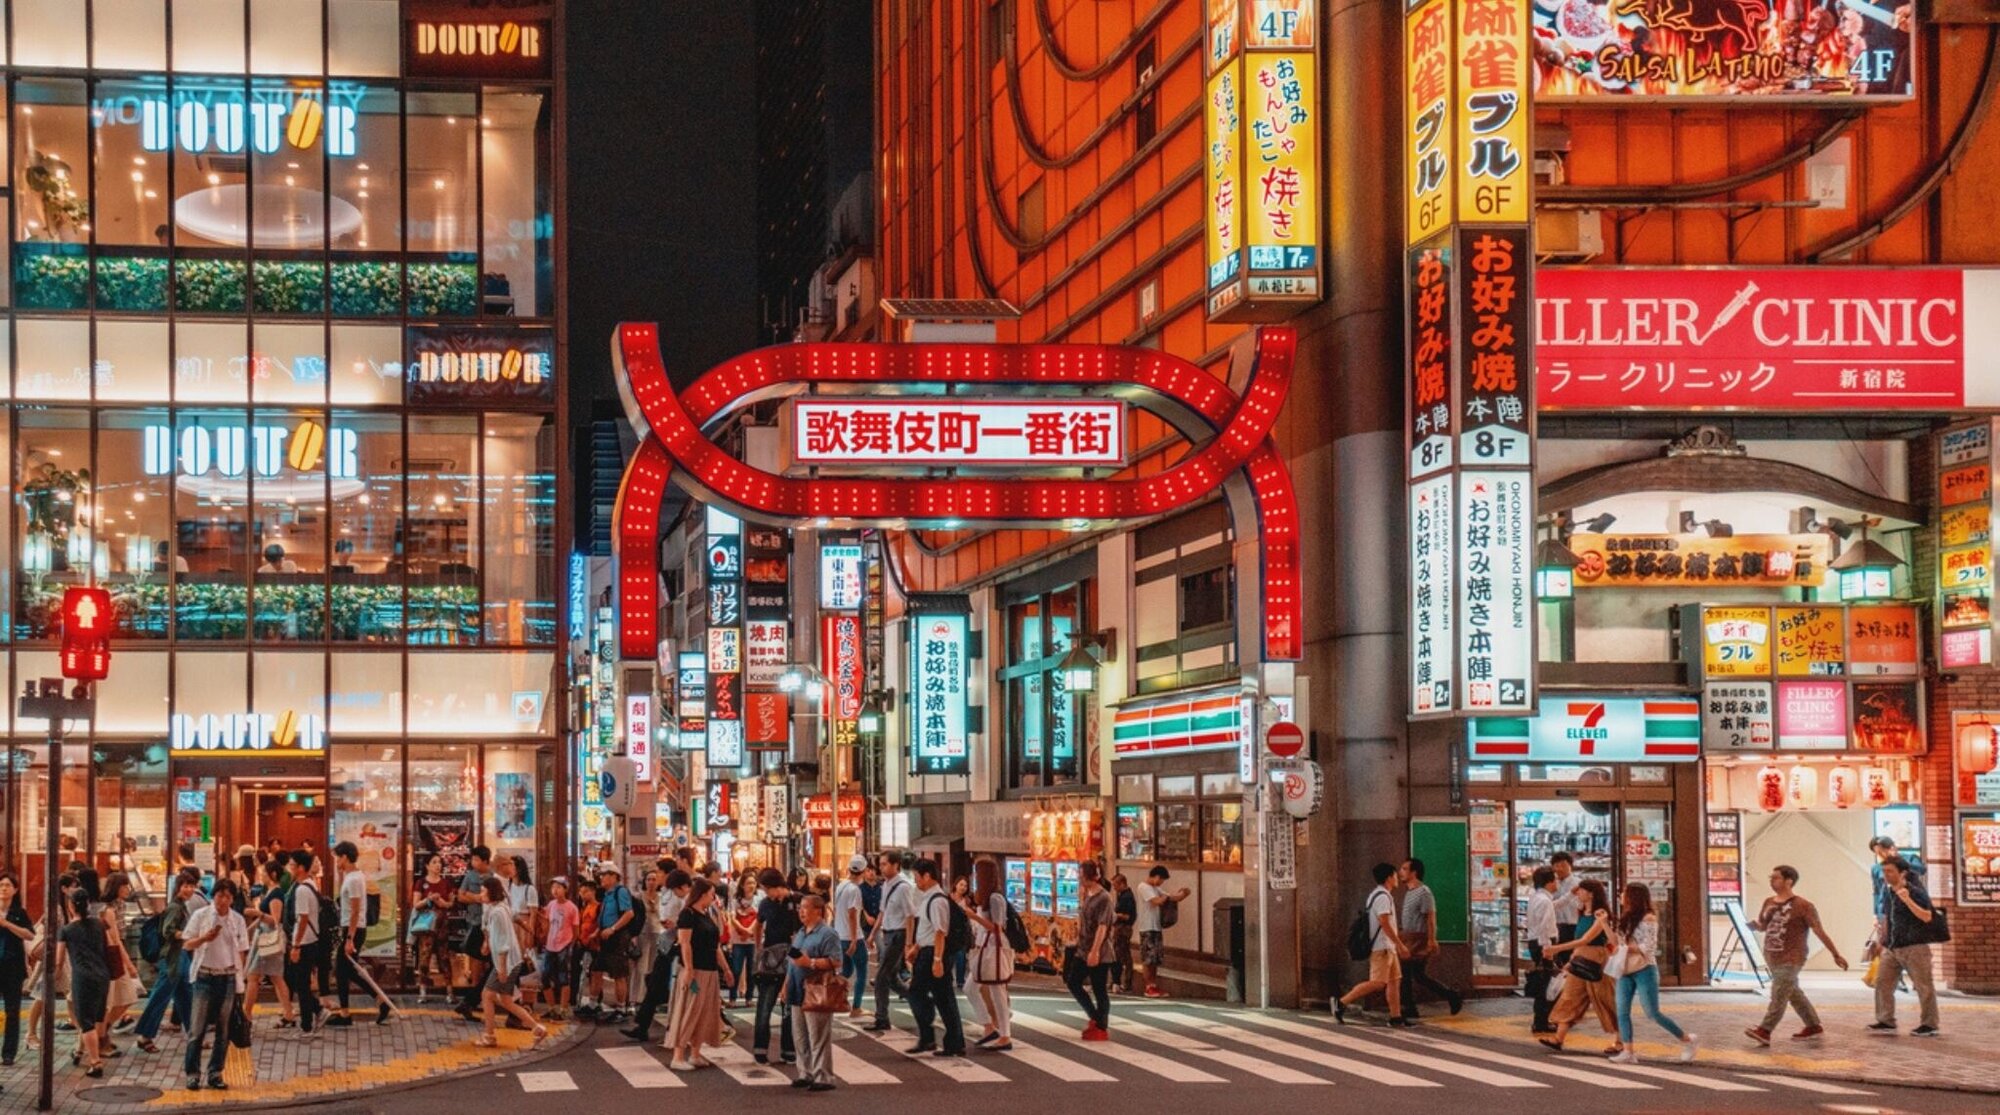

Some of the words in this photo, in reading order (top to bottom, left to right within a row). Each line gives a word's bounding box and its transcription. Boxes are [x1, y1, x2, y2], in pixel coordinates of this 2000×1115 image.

[417, 21, 541, 57] DOUTOR
[1260, 11, 1298, 38] 4F
[1214, 26, 1234, 60] 4F
[1850, 50, 1896, 82] 4F
[1277, 60, 1307, 124] お好み
[143, 98, 356, 156] DOUTOR
[1253, 119, 1279, 162] たこ
[1261, 166, 1300, 238] 焼き
[1420, 194, 1443, 231] 6F
[1474, 185, 1512, 214] 6F
[1287, 247, 1309, 268] 7F
[1258, 279, 1306, 293] 小松ビル
[1416, 249, 1446, 406] お好み焼
[1471, 234, 1518, 392] お好み焼
[1536, 298, 1702, 346] ILLER
[1752, 297, 1957, 347] CLINIC
[420, 349, 542, 384] DOUTOR
[1536, 362, 1608, 393] ラー
[1617, 361, 1777, 393] クリニック
[1839, 368, 1907, 389] 新宿院
[1415, 403, 1448, 435] 本陣
[1466, 395, 1524, 424] 本陣
[143, 419, 358, 477] DOUTOR
[805, 410, 1111, 455] 歌舞伎町一番街
[1475, 430, 1515, 458] 8F
[1421, 441, 1444, 467] 8F
[1510, 481, 1523, 573] OKONOMIYAKI
[1416, 508, 1432, 686] お好み焼き本陣
[1466, 498, 1493, 682] お好み焼き本陣
[1512, 577, 1524, 629] HONJIN
[749, 625, 785, 642] 焼肉
[722, 659, 737, 671] 2F
[1720, 645, 1753, 661] ブル
[1754, 665, 1769, 674] 6F
[1434, 683, 1450, 704] 2F
[1501, 682, 1525, 702] 2F
[1786, 687, 1834, 699] FILLER
[1786, 701, 1835, 713] CLINIC
[172, 708, 324, 750] DOUTOR
[931, 757, 951, 769] 2F
[420, 817, 468, 827] Information
